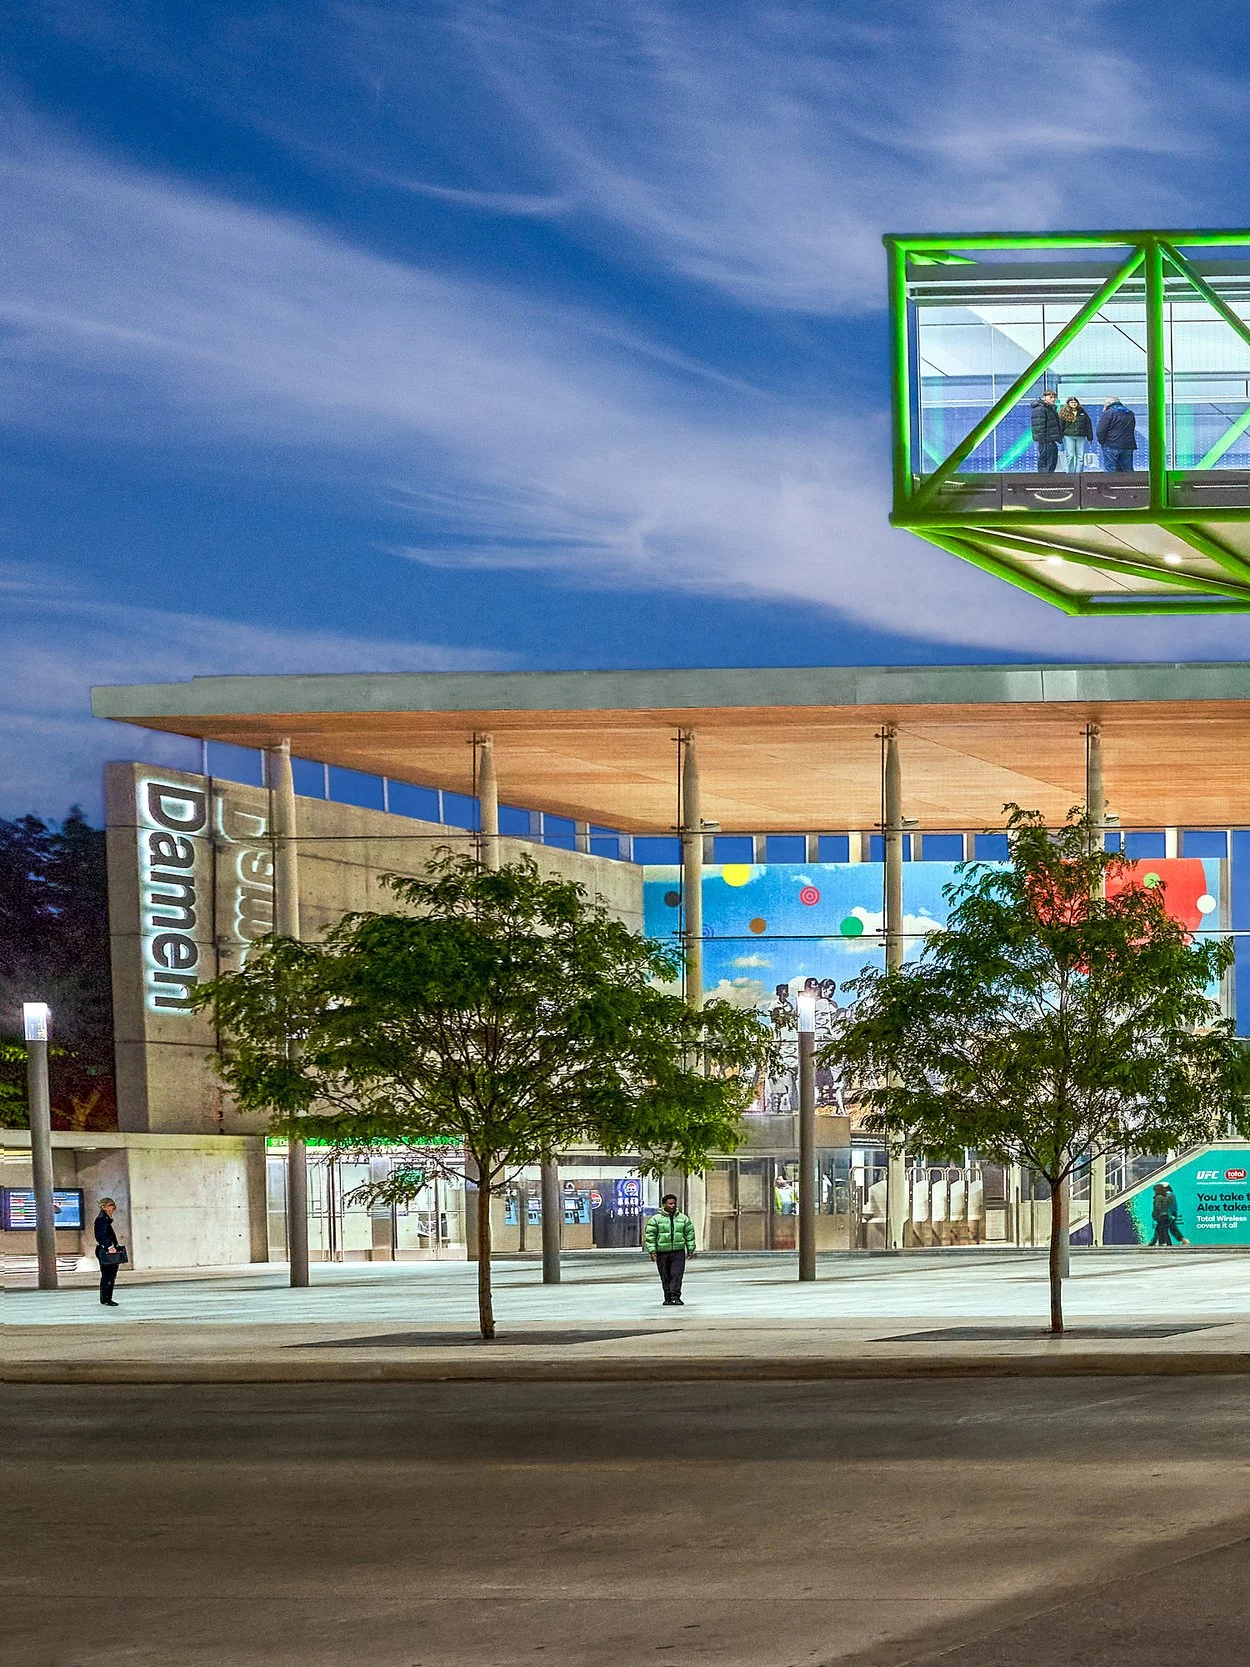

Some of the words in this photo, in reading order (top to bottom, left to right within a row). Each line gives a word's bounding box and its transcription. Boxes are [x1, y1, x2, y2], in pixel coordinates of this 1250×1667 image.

[147, 782, 209, 1010] Damen
[1196, 1170, 1220, 1180] UFC
[1196, 1192, 1217, 1201] You
[1219, 1192, 1244, 1201] take
[1196, 1202, 1220, 1212] Alex
